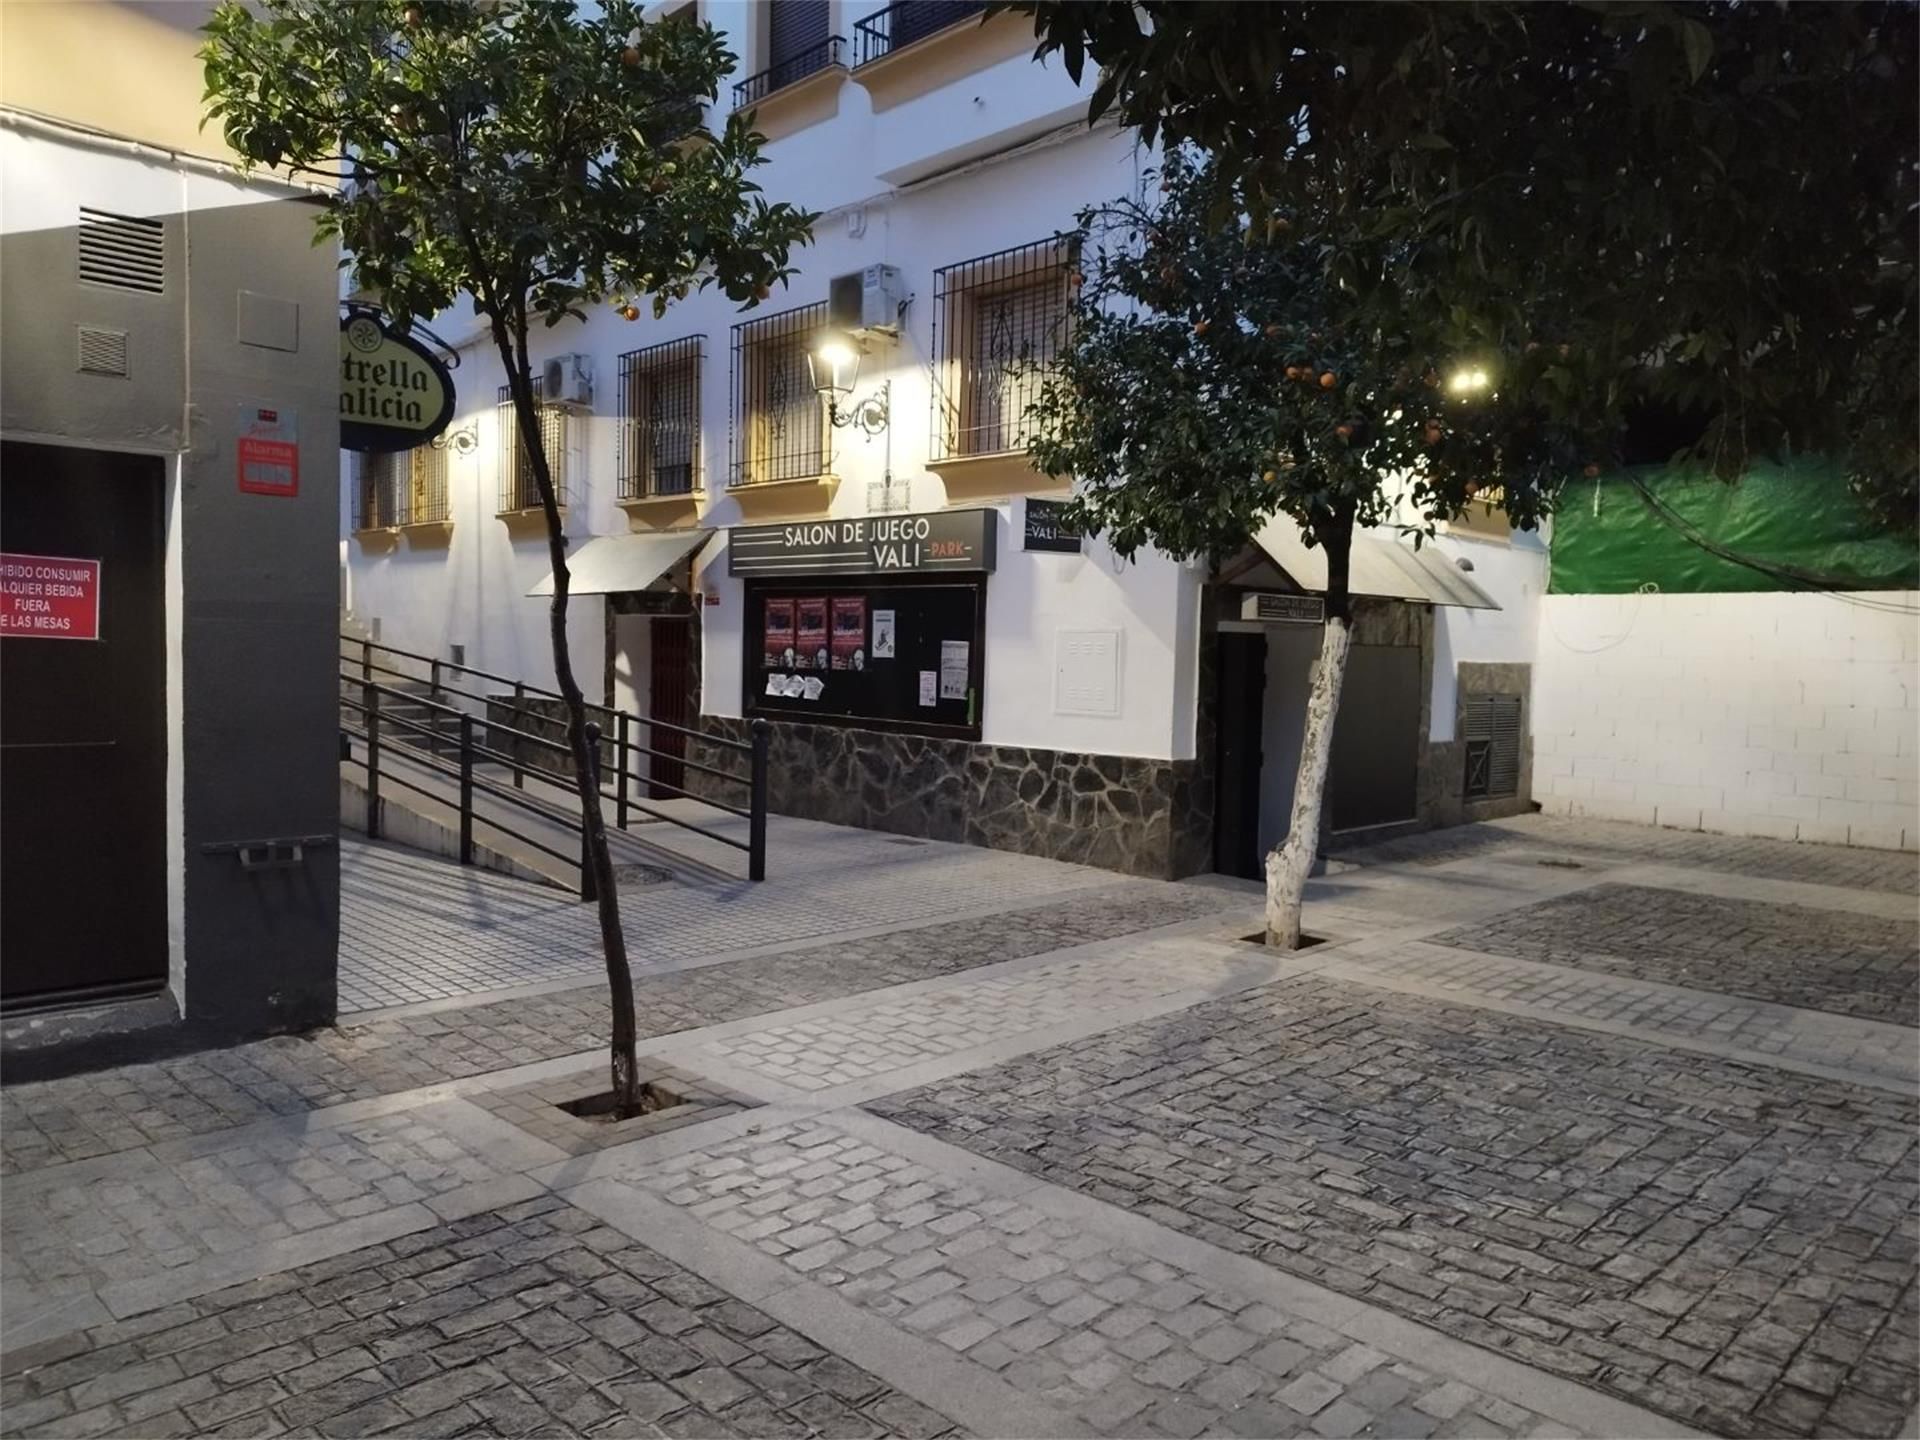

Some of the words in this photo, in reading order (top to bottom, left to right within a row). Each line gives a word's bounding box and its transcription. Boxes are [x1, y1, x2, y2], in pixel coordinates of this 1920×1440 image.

[785, 525, 837, 547] SALON
[843, 522, 863, 544] DE
[869, 518, 930, 542] JUEGO
[1032, 526, 1057, 539] VALI
[873, 543, 919, 568] VALI
[931, 541, 964, 556] PARK
[36, 567, 90, 582] CONSUMIR
[45, 584, 84, 598] BEBIDA
[15, 598, 50, 612] FUERA
[11, 615, 31, 628] LAS
[34, 616, 71, 630] MESAS
